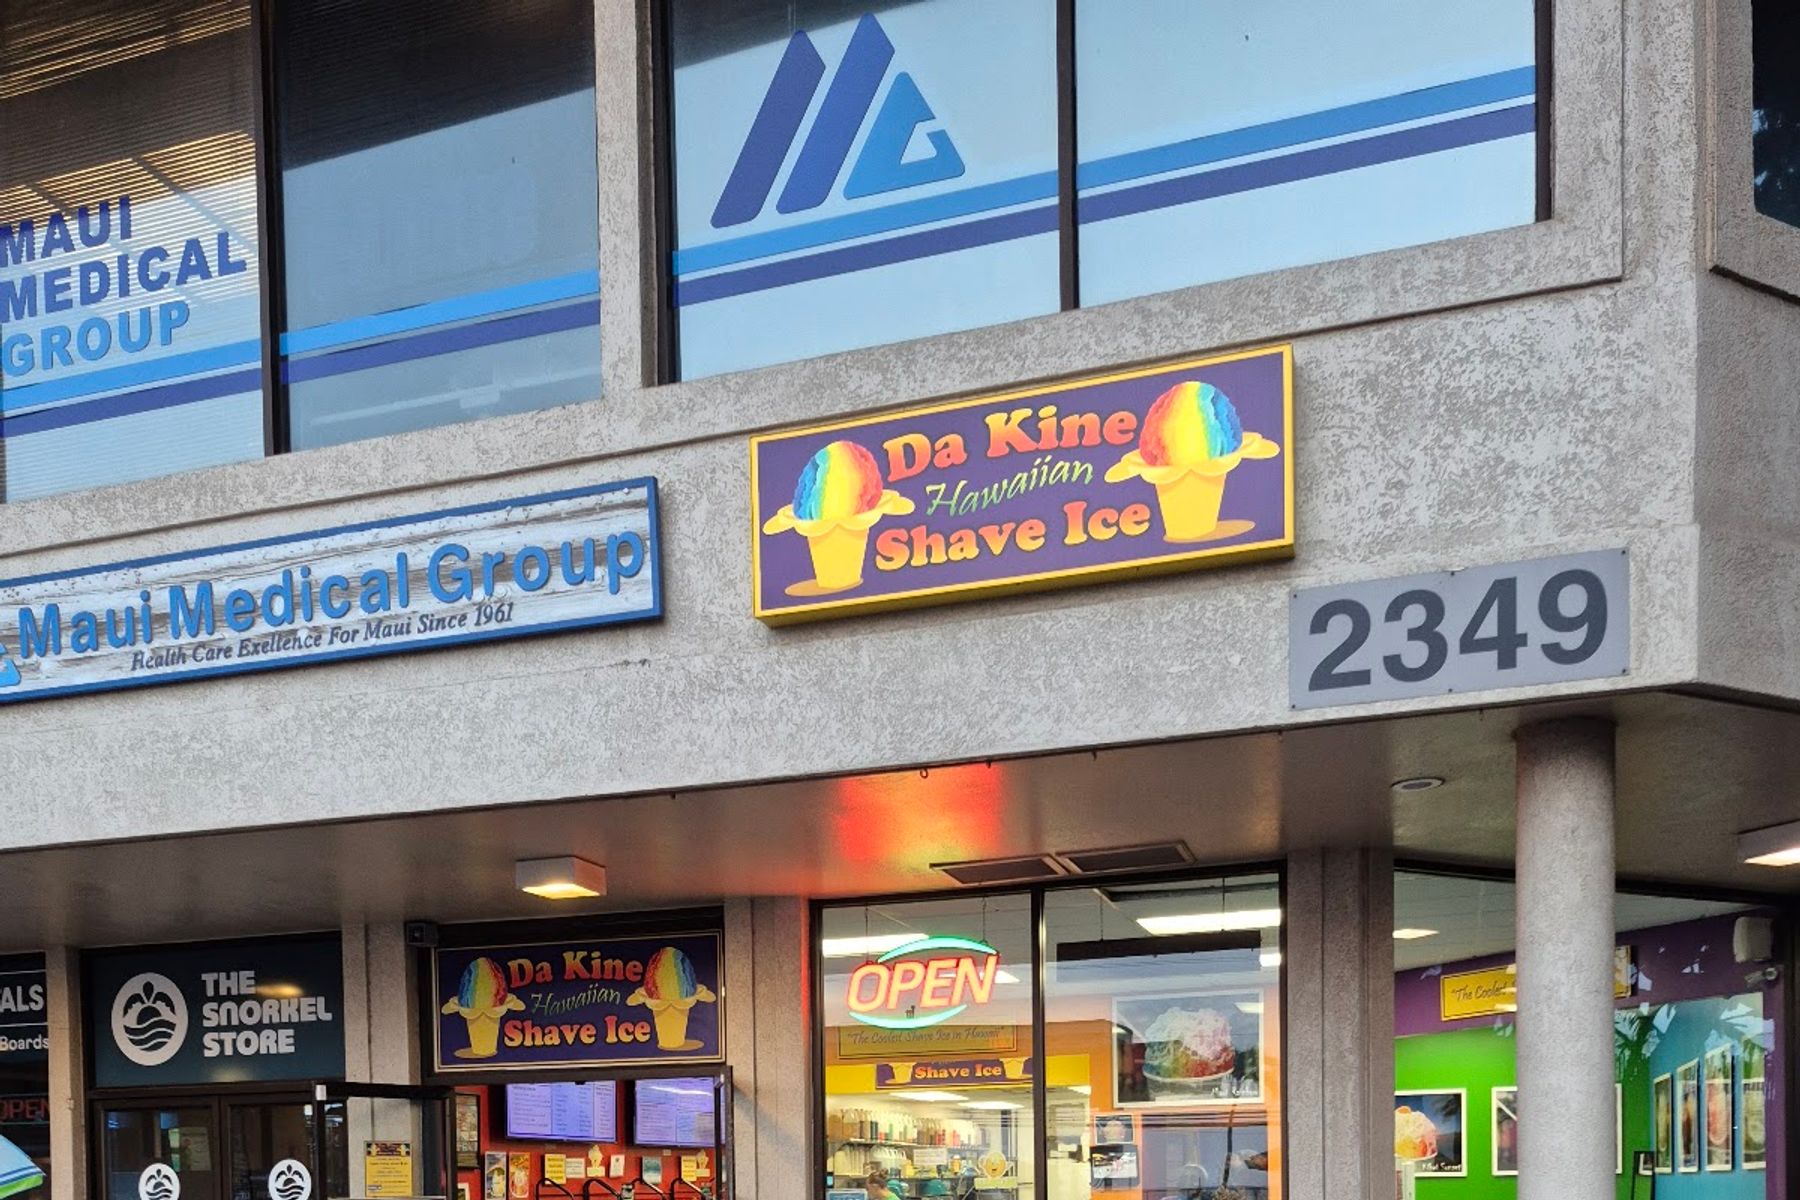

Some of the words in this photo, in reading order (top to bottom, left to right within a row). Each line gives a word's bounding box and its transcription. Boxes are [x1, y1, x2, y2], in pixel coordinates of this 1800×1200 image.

[0, 194, 132, 268] MAUI
[0, 231, 247, 323] MEDICAL
[1, 300, 190, 377] GROUP
[882, 433, 967, 482] Da
[984, 405, 1138, 458] Kine
[925, 455, 1094, 517] Hawaiian
[875, 518, 1047, 571] Shave
[1063, 501, 1151, 546] Ice
[18, 590, 153, 659] Maui
[168, 551, 409, 640] Medical
[428, 531, 644, 604] Group
[131, 650, 187, 671] Health
[192, 641, 234, 663] Care
[327, 624, 359, 645] For
[363, 617, 412, 641] Maui
[417, 610, 468, 634] Since
[474, 601, 514, 626] 1961
[1308, 568, 1608, 692] 2349
[0, 984, 45, 1013] ALS
[201, 970, 257, 997] THE
[507, 958, 552, 988] Da
[562, 951, 643, 982] Kine
[530, 983, 621, 1016] Hawaiian
[846, 951, 999, 1014] OPEN
[202, 996, 333, 1028] SNORKEL
[503, 1019, 597, 1047] Shave
[604, 1015, 651, 1044] Ice
[202, 1029, 295, 1058] STORE
[915, 1066, 970, 1079] Shave
[975, 1063, 1001, 1077] Ice
